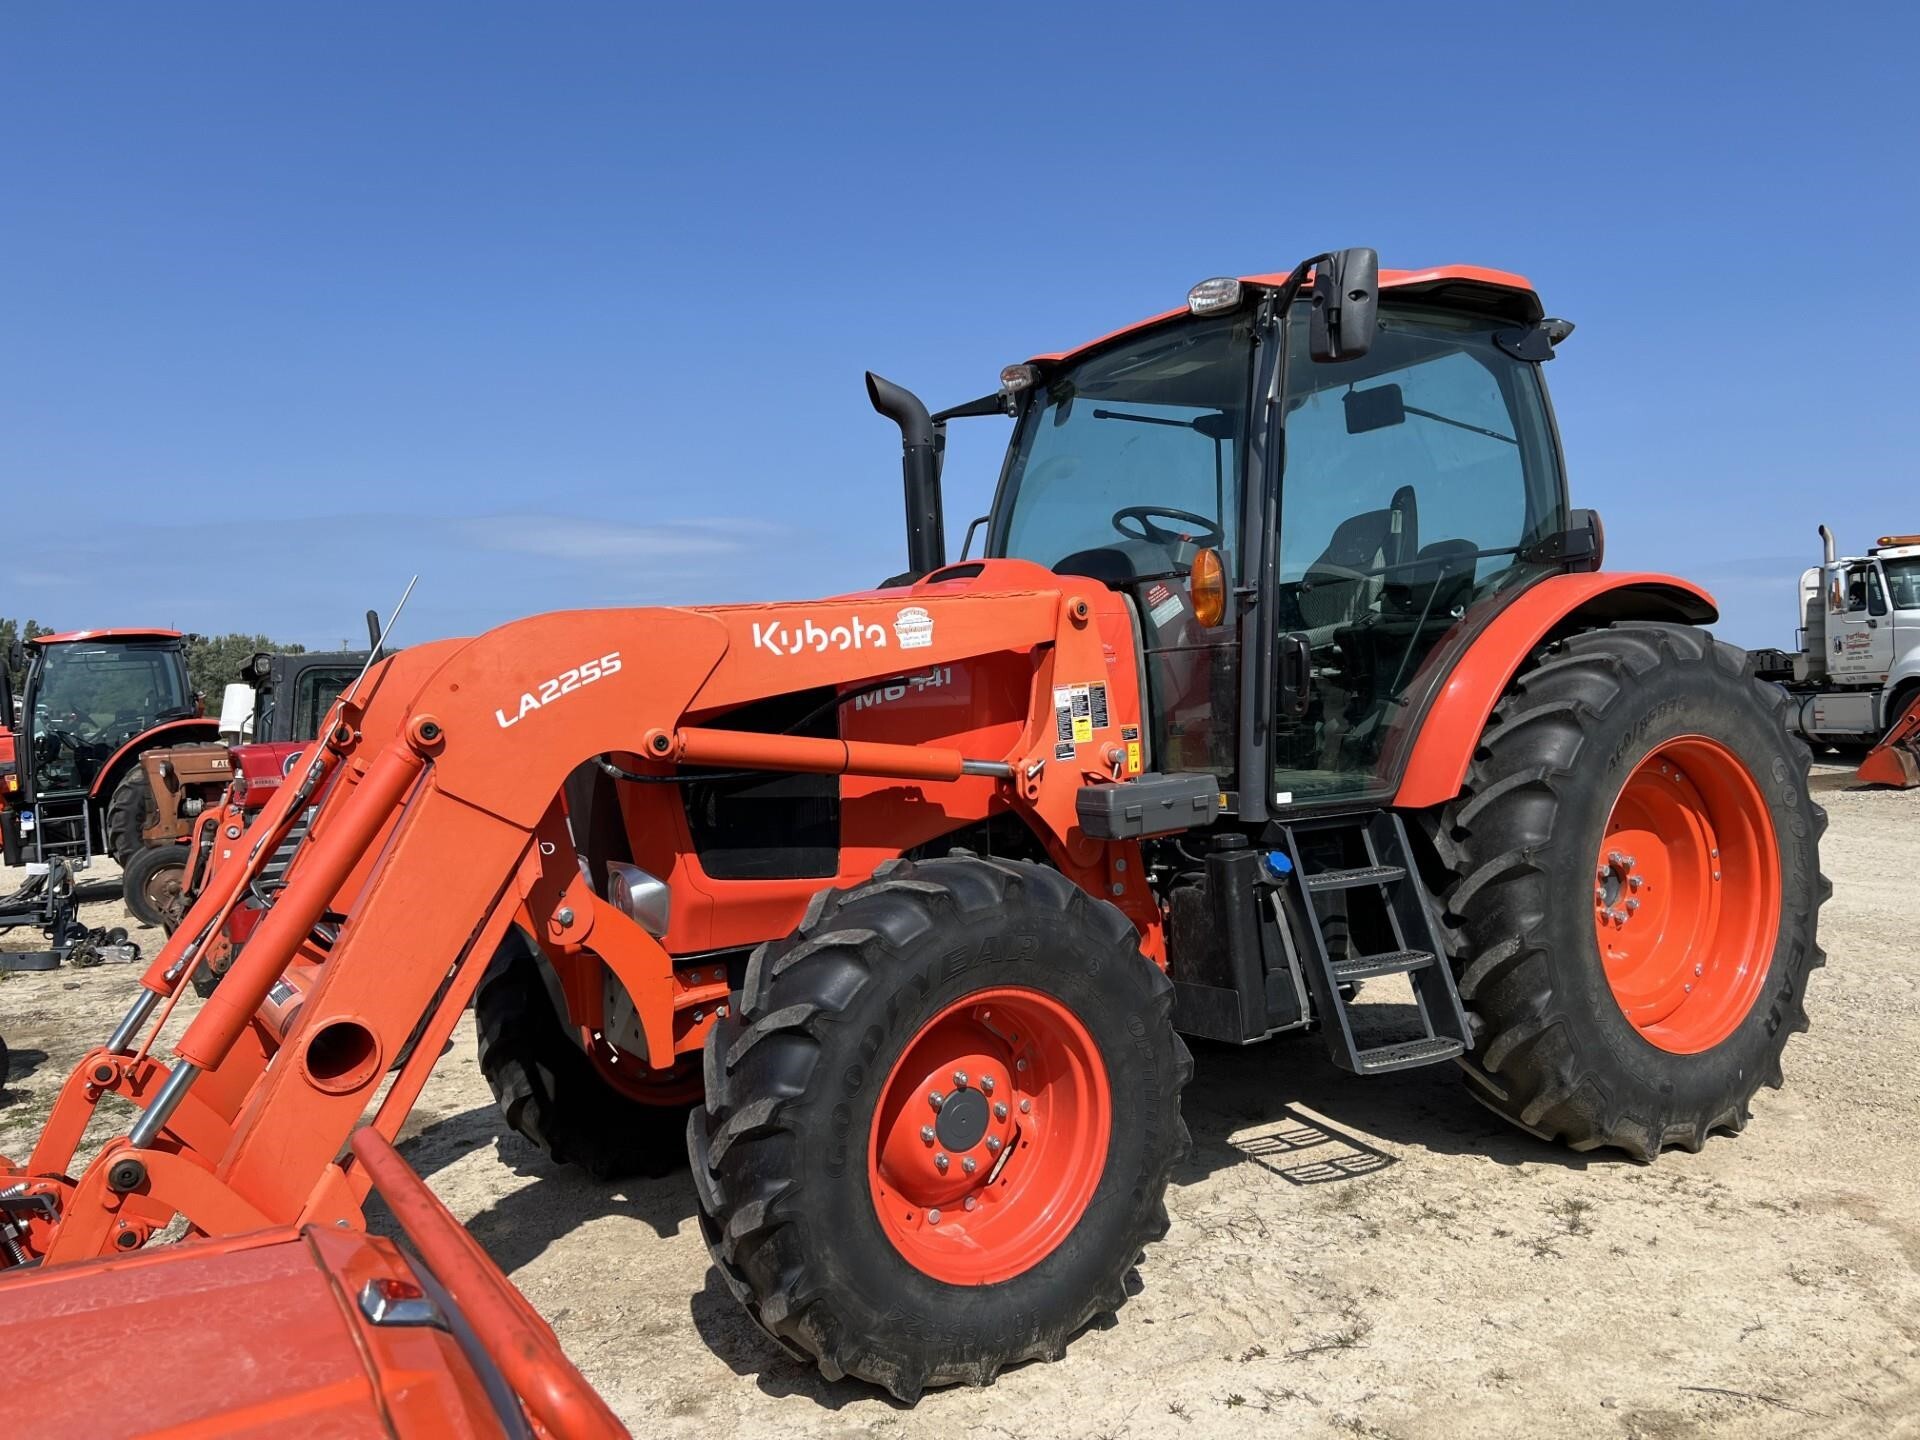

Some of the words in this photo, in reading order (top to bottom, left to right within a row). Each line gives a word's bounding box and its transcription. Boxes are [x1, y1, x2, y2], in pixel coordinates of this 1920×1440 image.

[495, 650, 623, 729] LA2255
[752, 615, 887, 657] Kubota
[1764, 756, 1808, 1039] GOODYEAR
[824, 933, 1040, 1179] GOODYEAR
